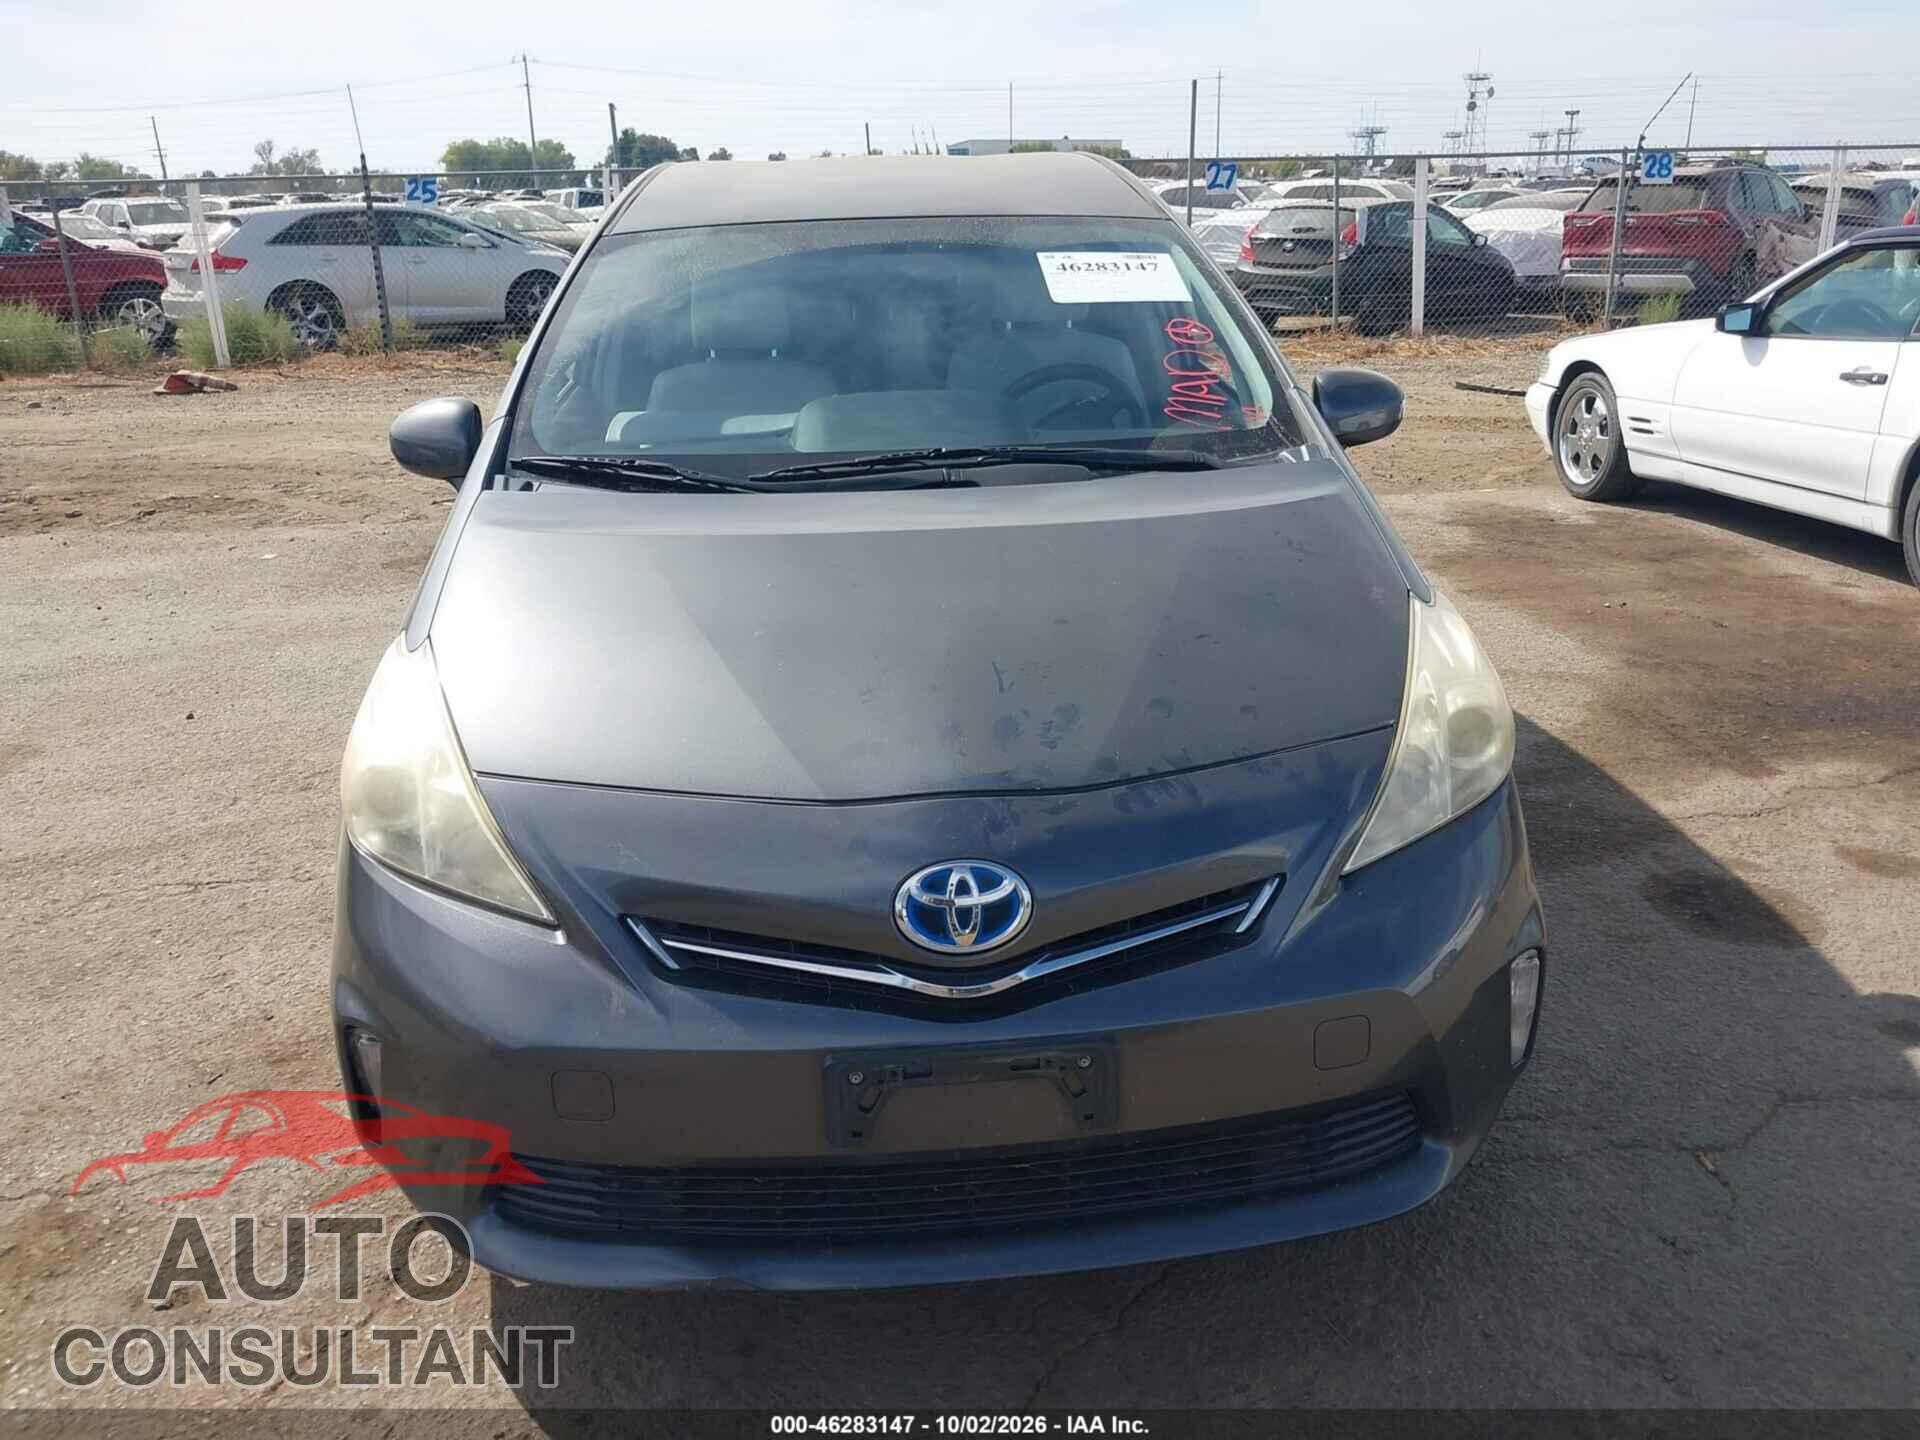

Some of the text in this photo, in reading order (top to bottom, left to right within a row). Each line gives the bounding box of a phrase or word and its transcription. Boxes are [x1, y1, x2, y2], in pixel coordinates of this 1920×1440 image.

[1206, 161, 1237, 190] 27
[1644, 152, 1673, 178] 28
[406, 176, 438, 204] 25
[1055, 262, 1159, 272] 46283147
